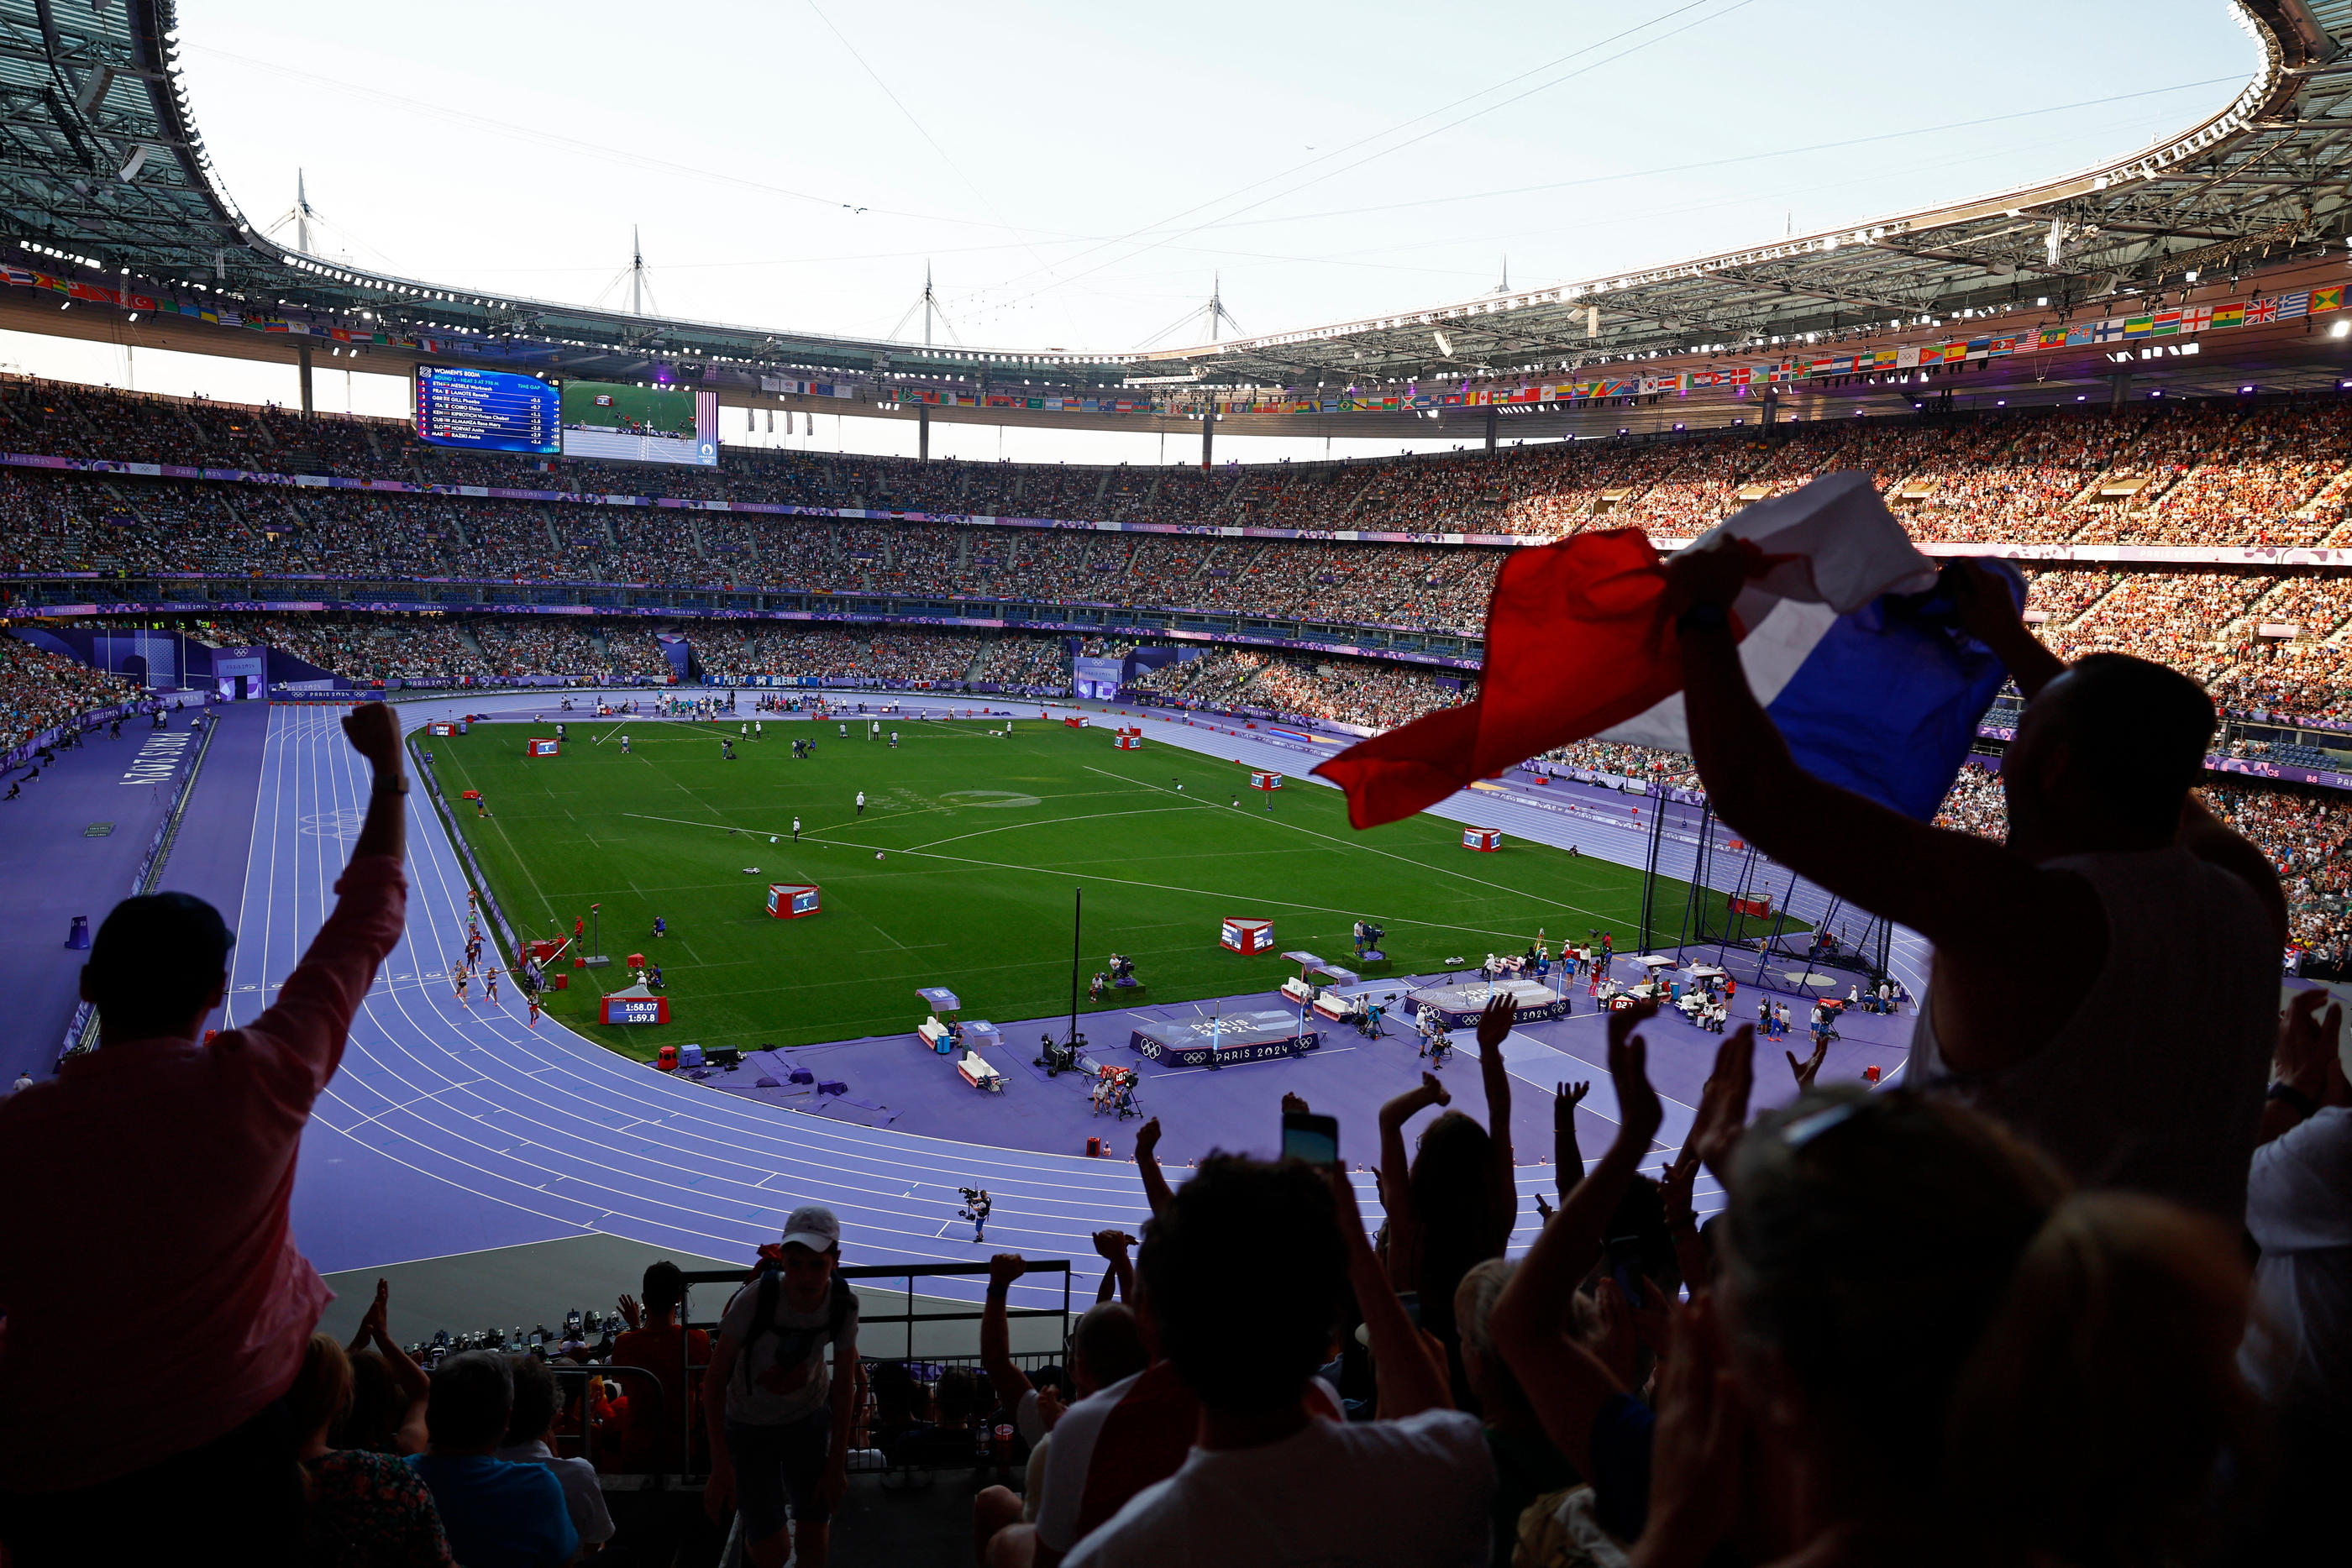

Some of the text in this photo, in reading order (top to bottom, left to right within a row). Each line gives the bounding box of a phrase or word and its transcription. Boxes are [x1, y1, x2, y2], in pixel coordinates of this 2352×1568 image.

[92, 710, 119, 721] PARIS 2024
[119, 733, 191, 784] PARIS 2024
[2268, 769, 2279, 777] C5
[1523, 1010, 1548, 1020] 2024
[1190, 1019, 1249, 1031] PARIS
[1200, 1025, 1260, 1037] 2024
[1215, 1046, 1288, 1062] PARIS 2024
